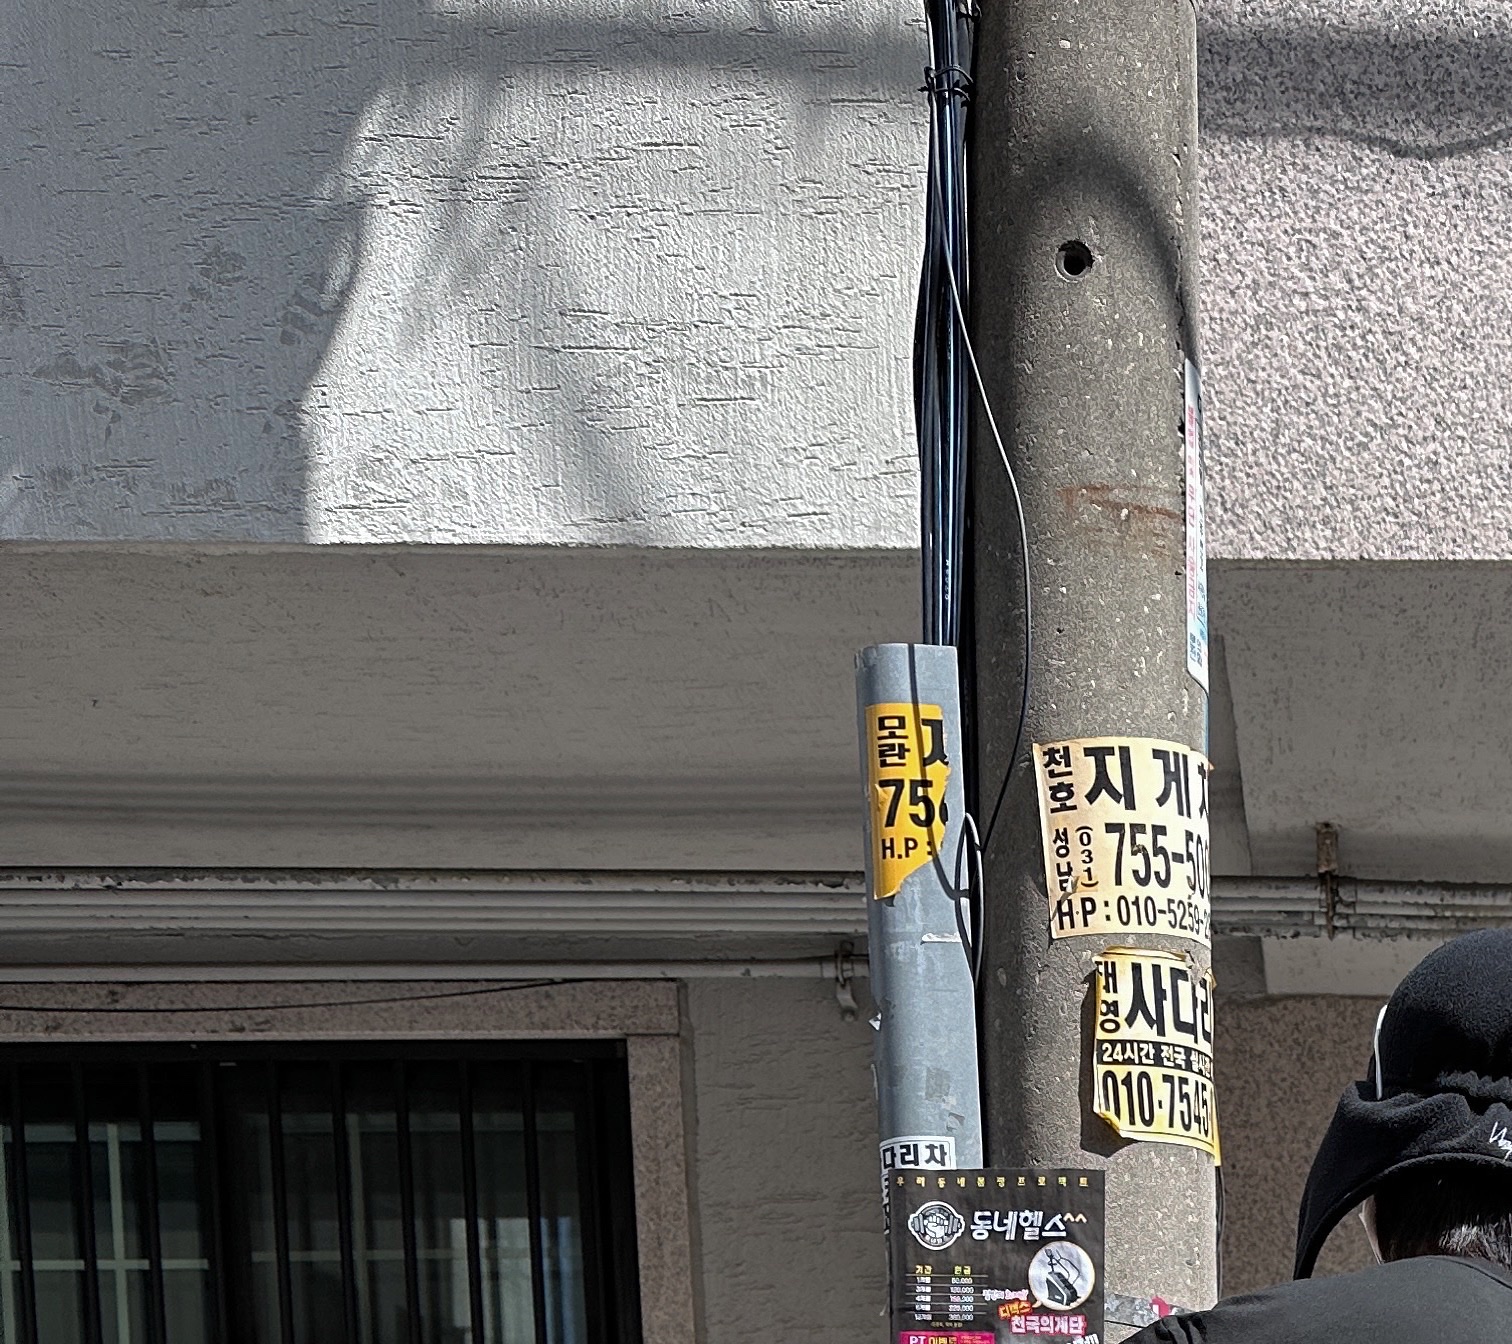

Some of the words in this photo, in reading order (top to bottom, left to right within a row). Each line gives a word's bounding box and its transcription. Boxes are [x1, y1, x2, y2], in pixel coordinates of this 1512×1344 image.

[877, 715, 911, 768] 모란
[878, 778, 949, 828] 75
[1042, 745, 1078, 814] 천호
[1101, 1042, 1155, 1065] 24시간
[1160, 1045, 1187, 1070] 전국
